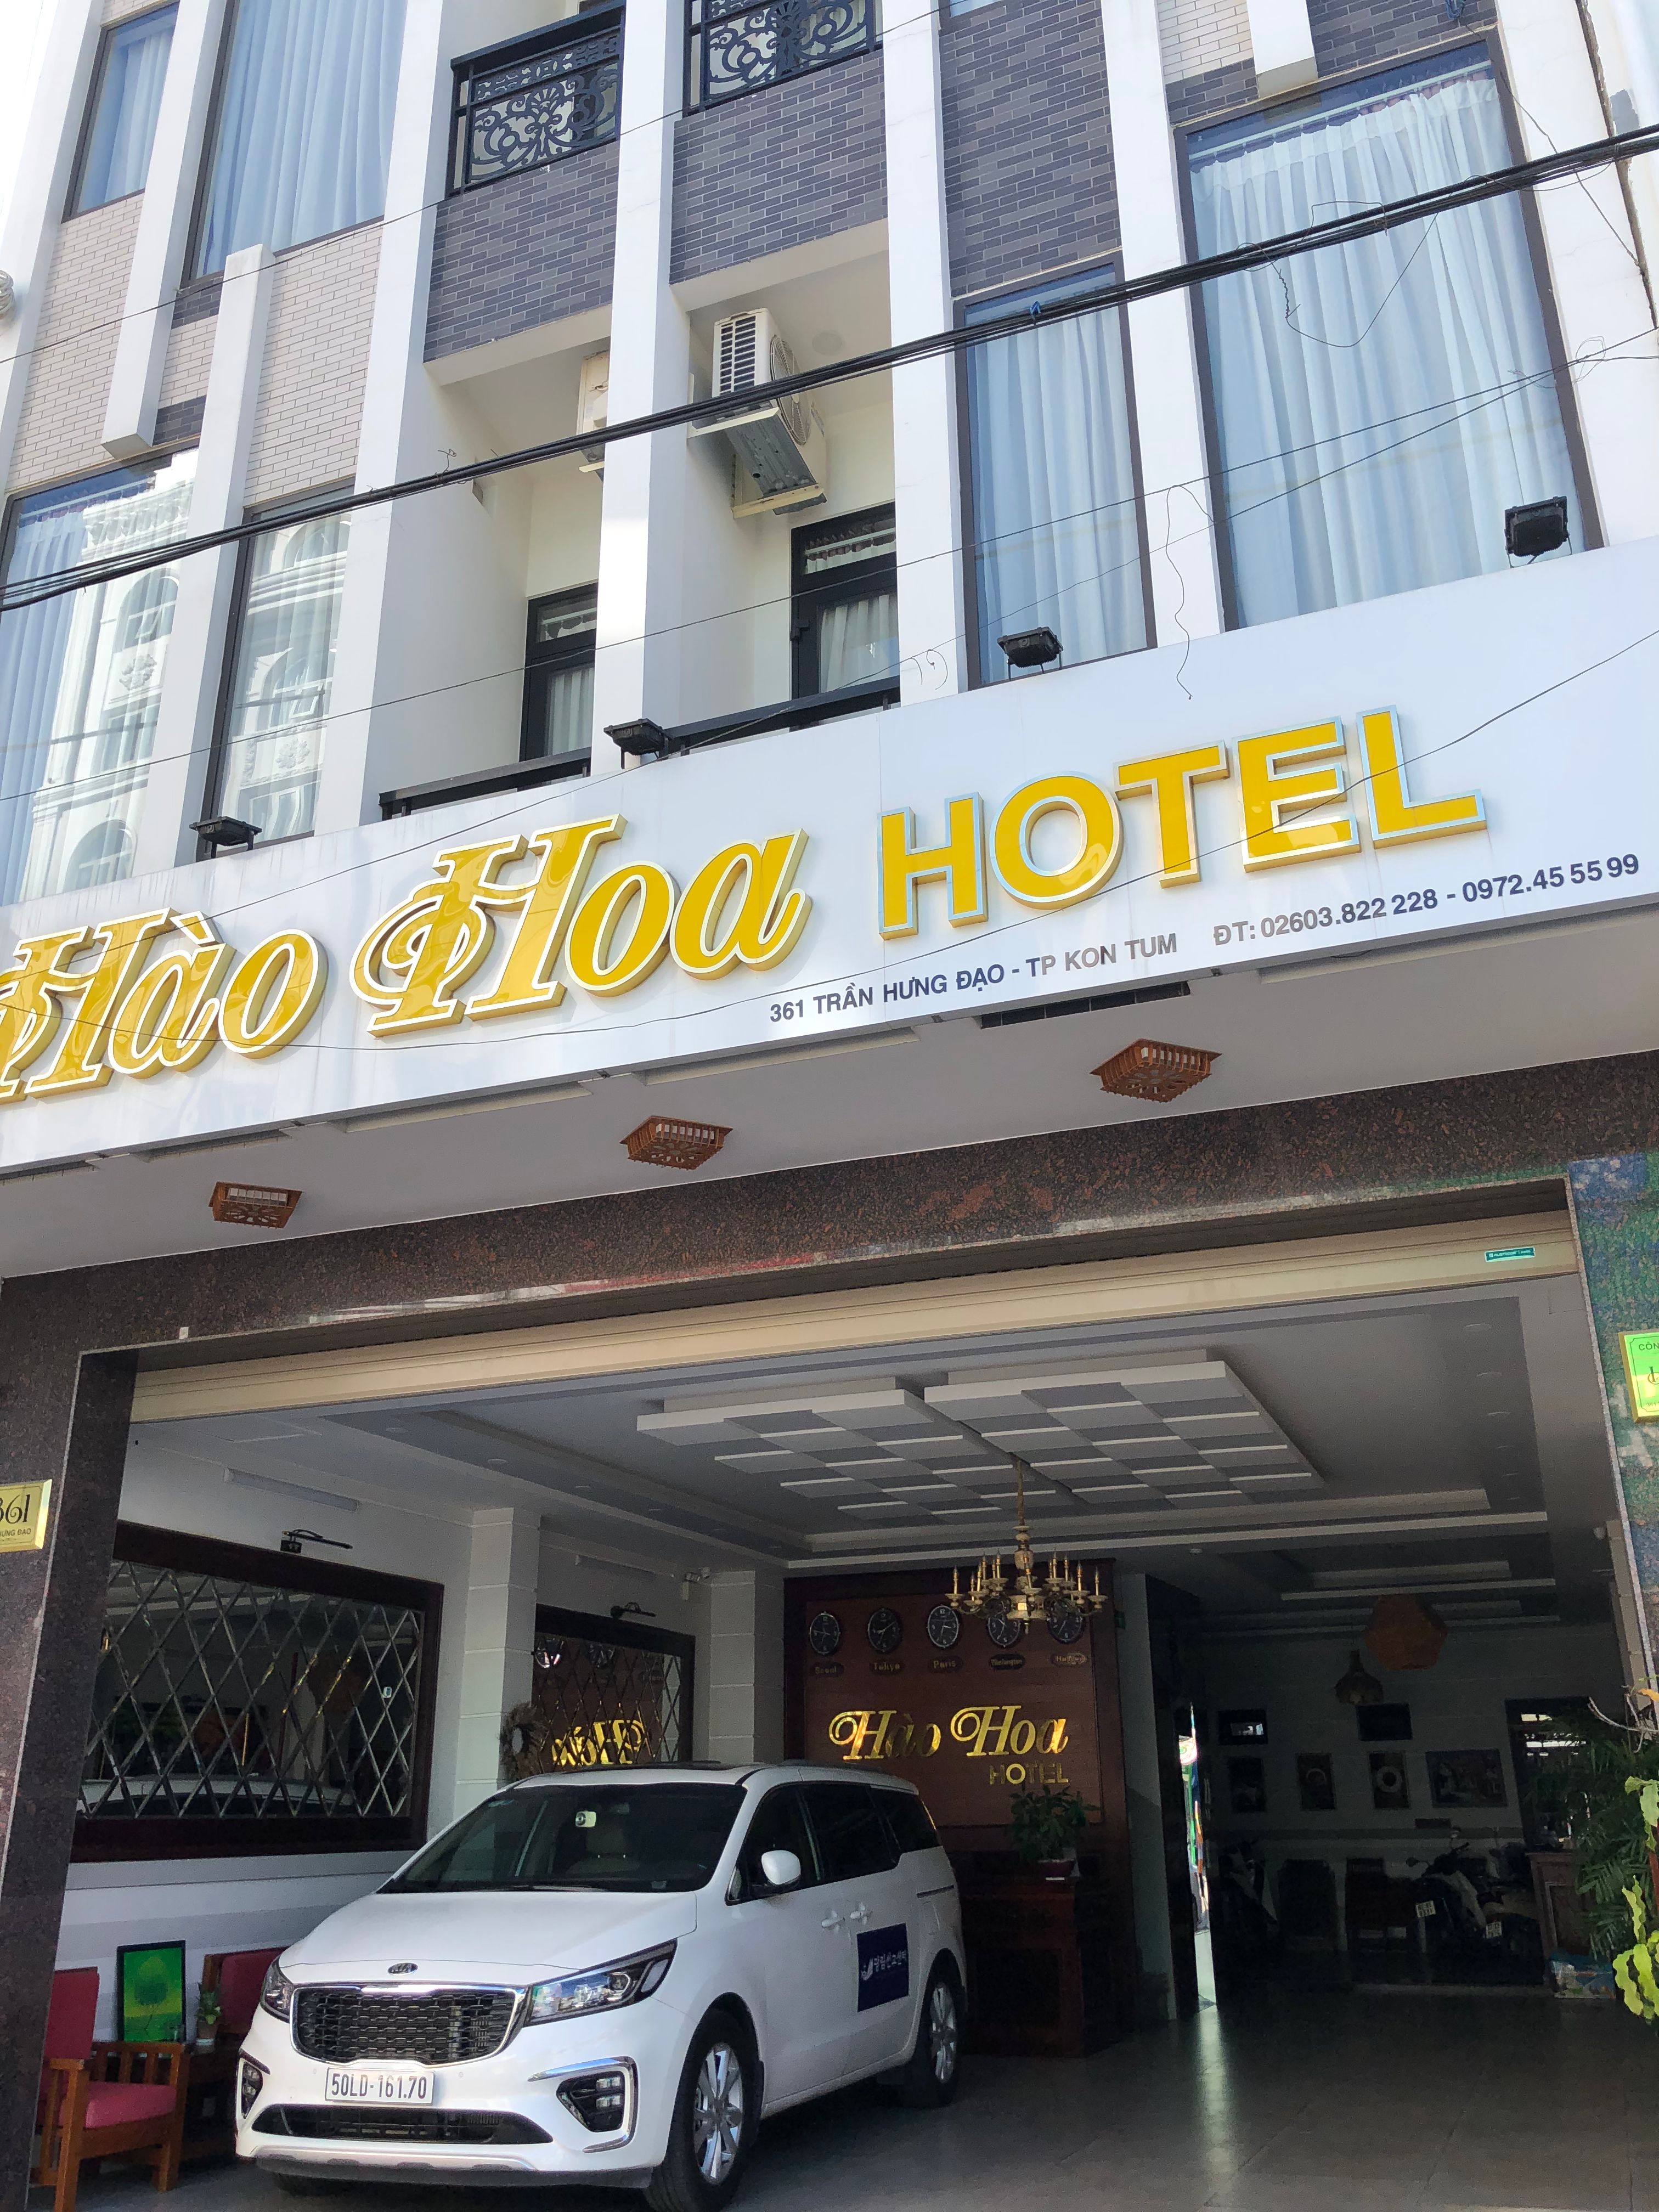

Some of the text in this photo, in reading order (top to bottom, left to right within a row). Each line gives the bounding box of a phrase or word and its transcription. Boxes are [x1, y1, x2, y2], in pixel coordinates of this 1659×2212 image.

[0, 704, 1488, 1104] Hào Hoa HOTEL
[770, 999, 803, 1022] 361
[812, 982, 873, 1014] TRẦN
[883, 974, 947, 1003] HƯNG
[956, 964, 1005, 992] ĐẠO
[1025, 955, 1056, 977] TP
[1065, 944, 1117, 971] KON
[1124, 933, 1177, 960] TUM
[1213, 921, 1255, 946] ĐT:
[933, 1660, 956, 1668] Paris
[828, 1705, 1069, 1760] Hào Hoa
[989, 1763, 1069, 1785] HOTEL
[331, 2073, 427, 2100] 50LD-161.70
